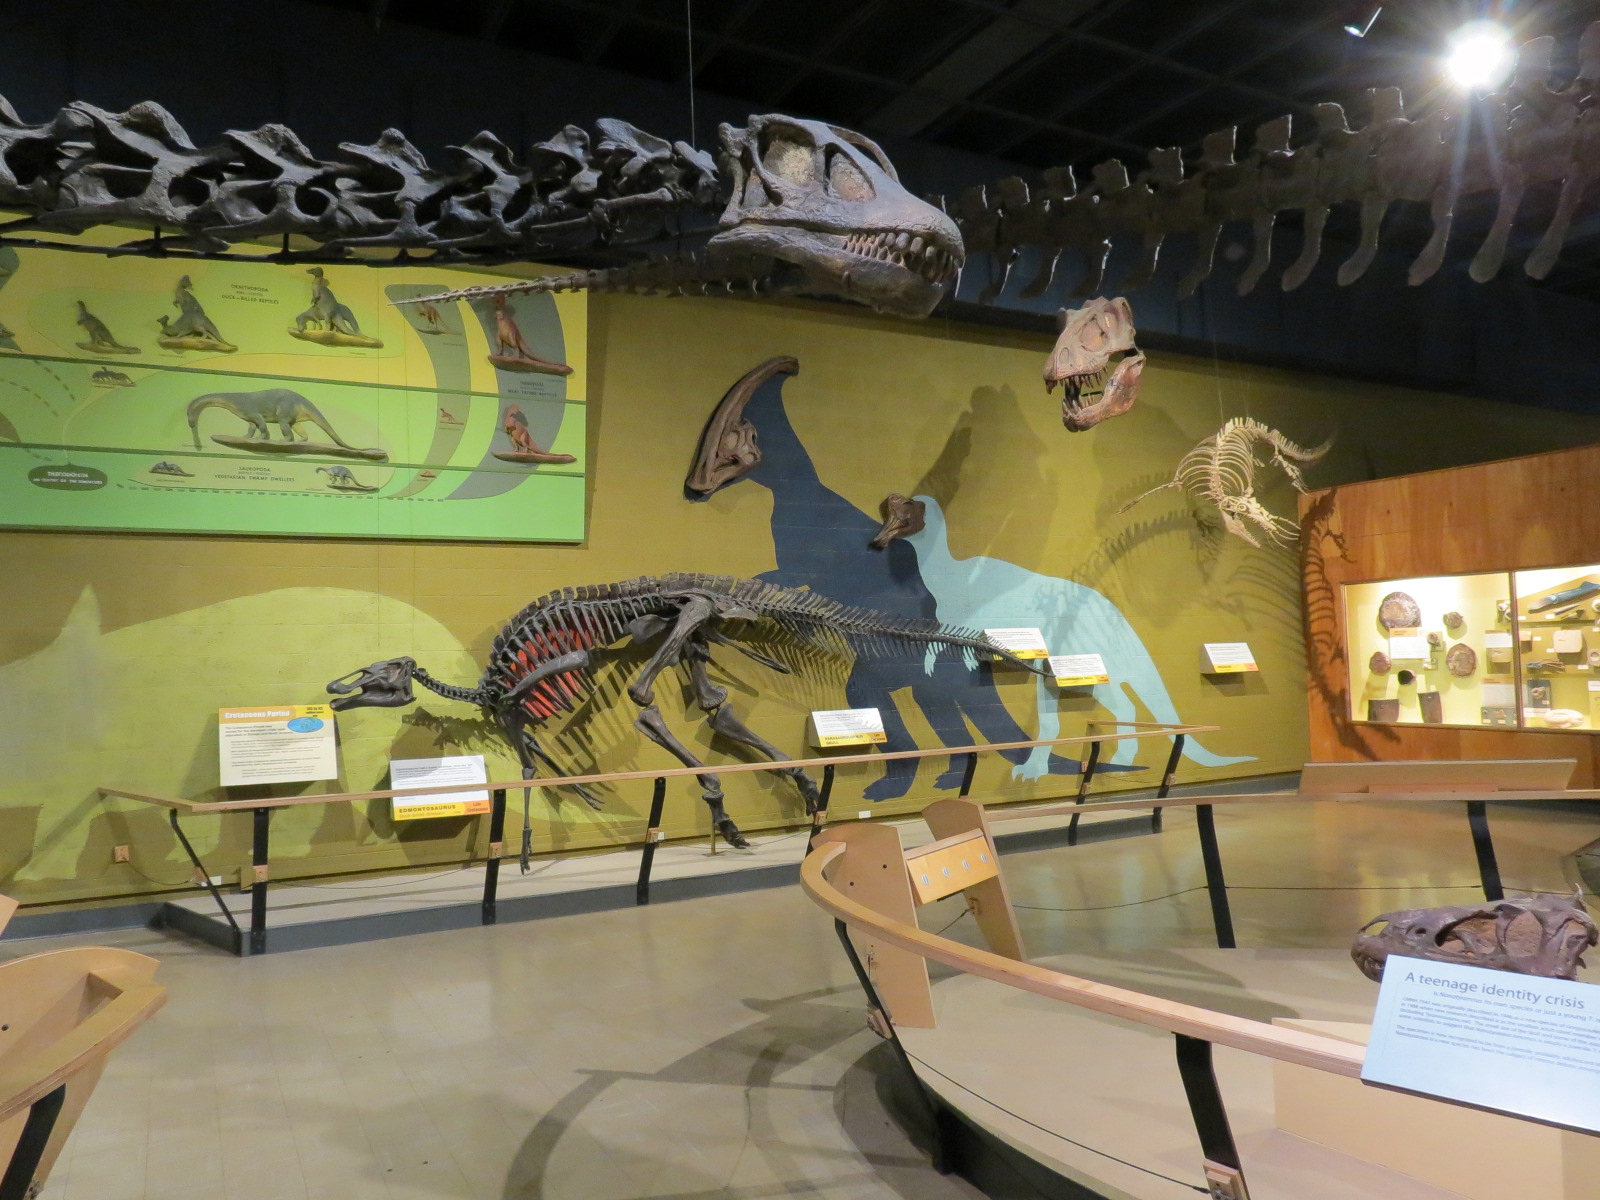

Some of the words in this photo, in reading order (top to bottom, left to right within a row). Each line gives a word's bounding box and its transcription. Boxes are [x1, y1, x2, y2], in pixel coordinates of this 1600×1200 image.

[399, 804, 456, 813] EDMONTOSAURUS
[1404, 972, 1415, 982] A
[1420, 975, 1478, 993] teenage
[1482, 984, 1541, 1004] identity
[1545, 995, 1584, 1009] crisis
[1564, 1013, 1586, 1021] young
